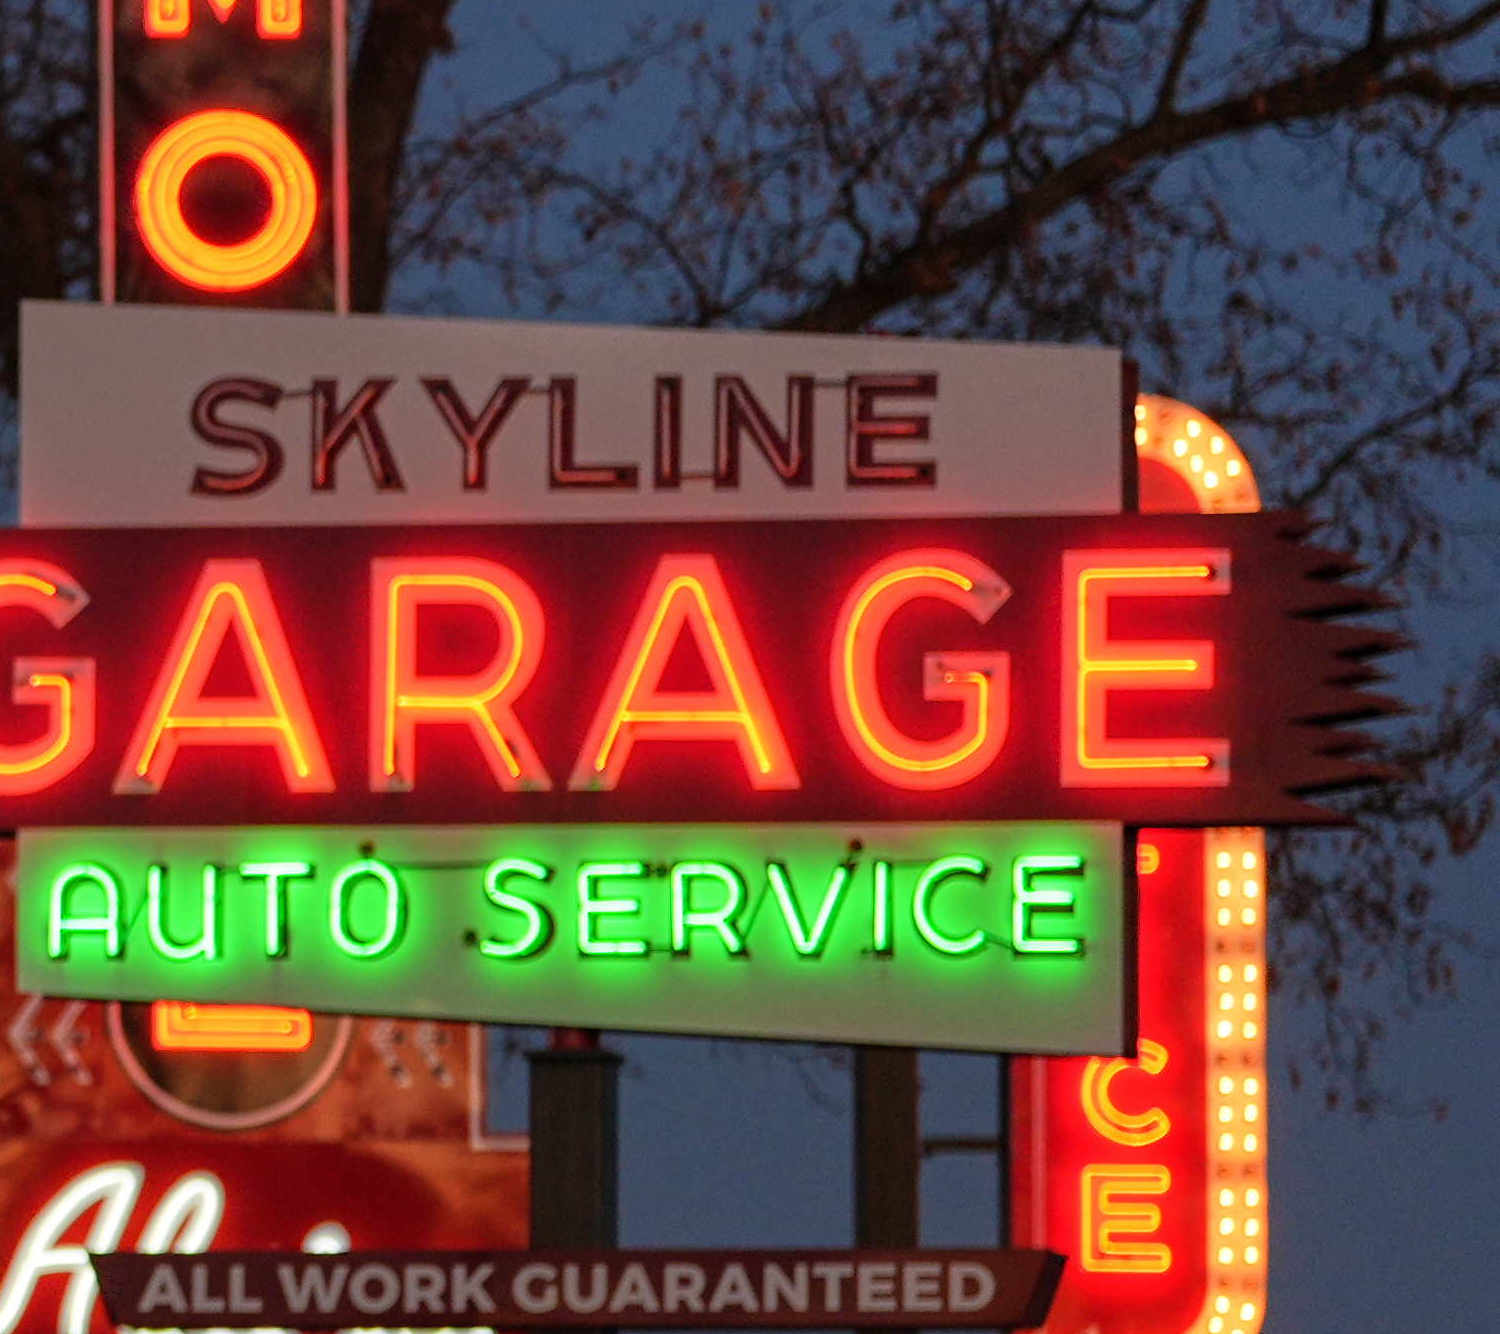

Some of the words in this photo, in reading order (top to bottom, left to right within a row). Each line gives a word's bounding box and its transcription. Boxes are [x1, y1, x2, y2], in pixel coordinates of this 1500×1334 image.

[189, 371, 940, 496] SKYLINE
[44, 853, 410, 964] AUTO
[476, 852, 1088, 960] SERVICE
[137, 1263, 264, 1314] ALL
[278, 1263, 497, 1315] WORK
[511, 1261, 998, 1315] GUARANTEED
